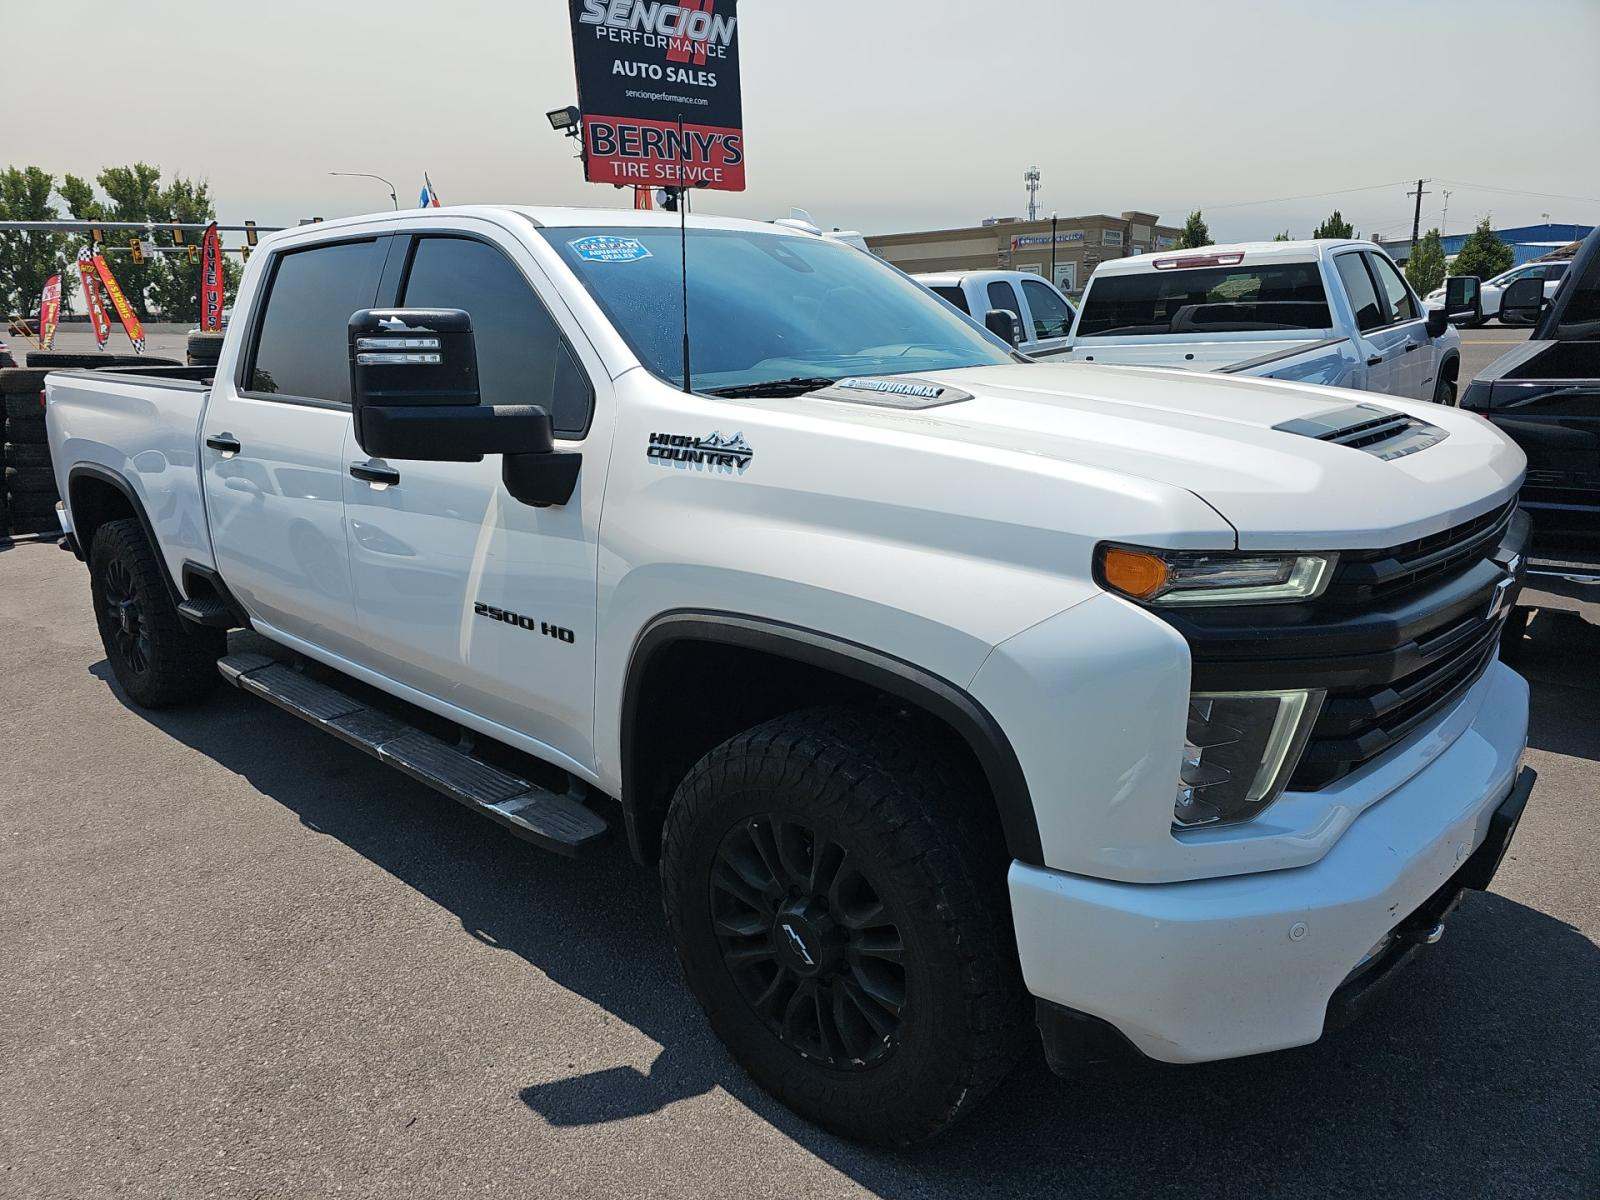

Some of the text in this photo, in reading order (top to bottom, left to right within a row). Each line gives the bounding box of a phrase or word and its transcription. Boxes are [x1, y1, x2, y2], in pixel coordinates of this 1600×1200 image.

[579, 0, 737, 46] SENCION
[596, 26, 727, 58] PERFORMANCE
[612, 59, 718, 88] AUTO SALES
[625, 88, 708, 106] sencionperformance.com
[588, 121, 743, 165] BERNY'S
[609, 161, 723, 182] TIRE SERVICE
[648, 432, 701, 448] HIGH
[646, 445, 753, 469] COUNTRY
[474, 601, 575, 644] 2500 HD
